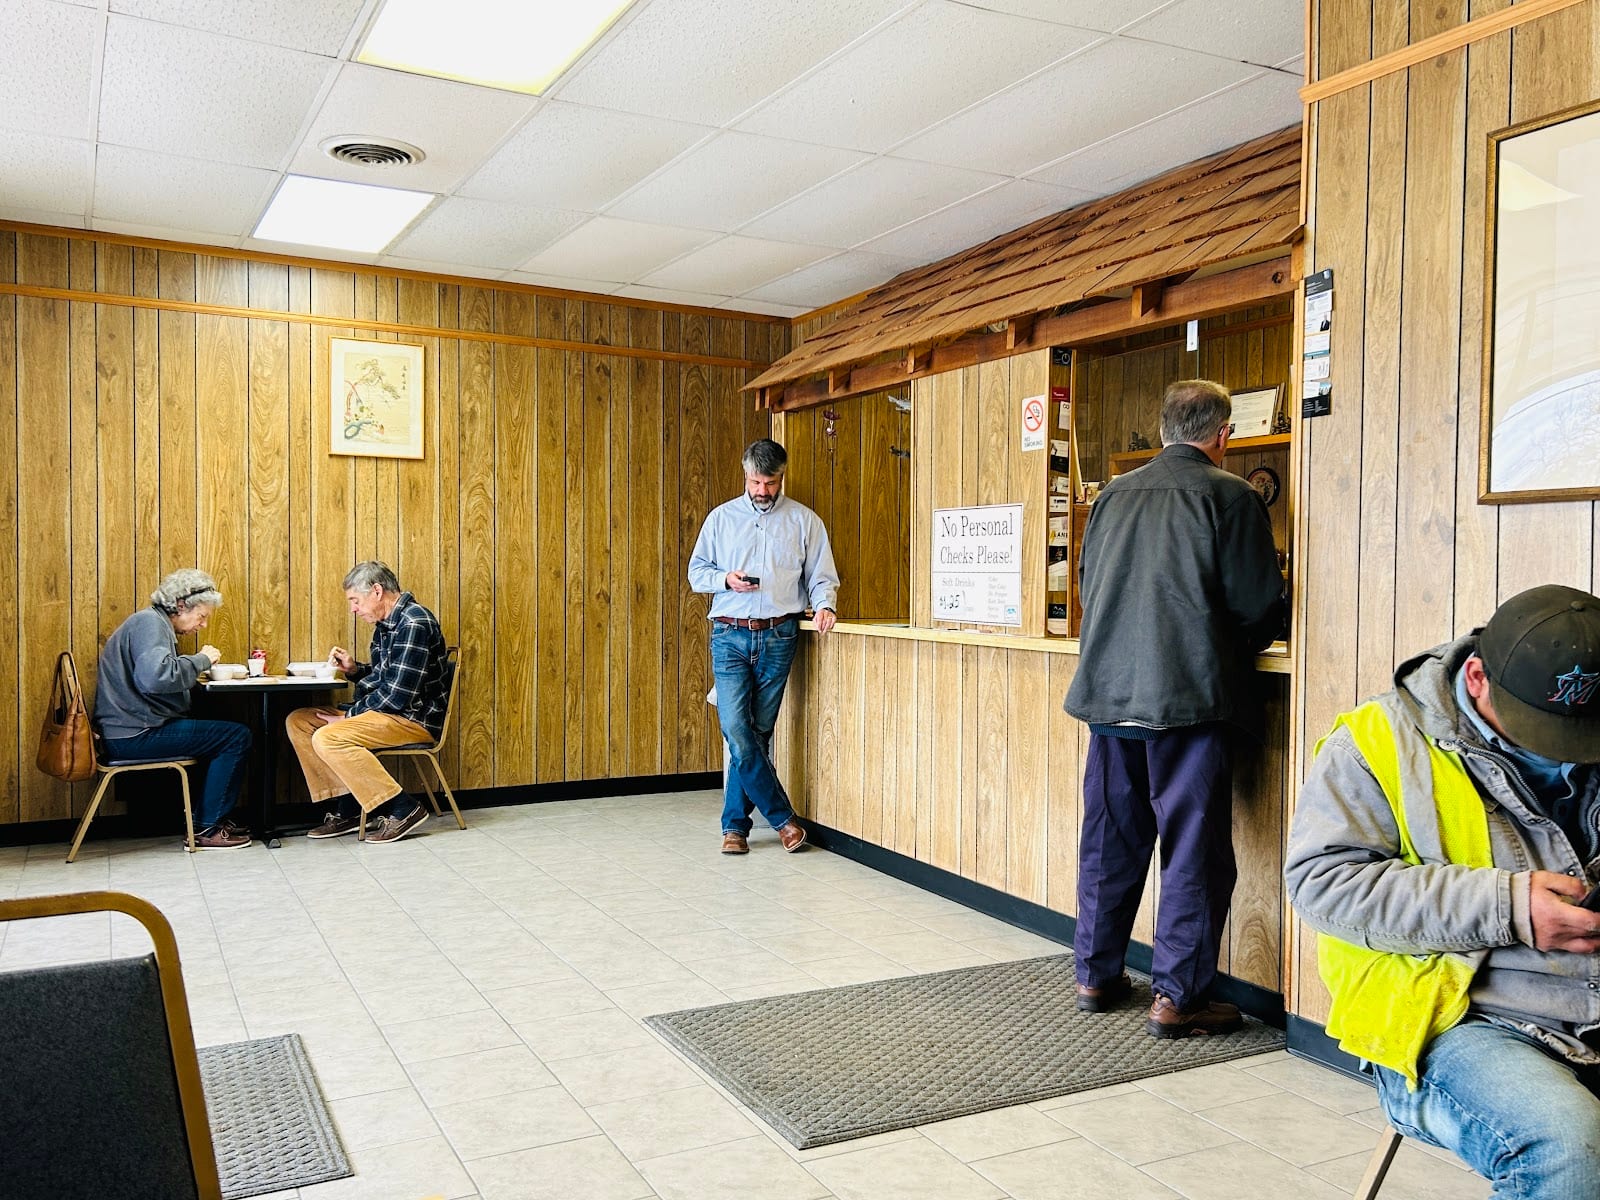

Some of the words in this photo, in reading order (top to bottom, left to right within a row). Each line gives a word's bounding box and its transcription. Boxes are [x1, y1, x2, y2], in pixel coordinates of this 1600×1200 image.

[941, 516, 958, 538] No
[960, 512, 1014, 537] Personal
[940, 546, 974, 565] Checks
[977, 544, 1013, 564] Please!
